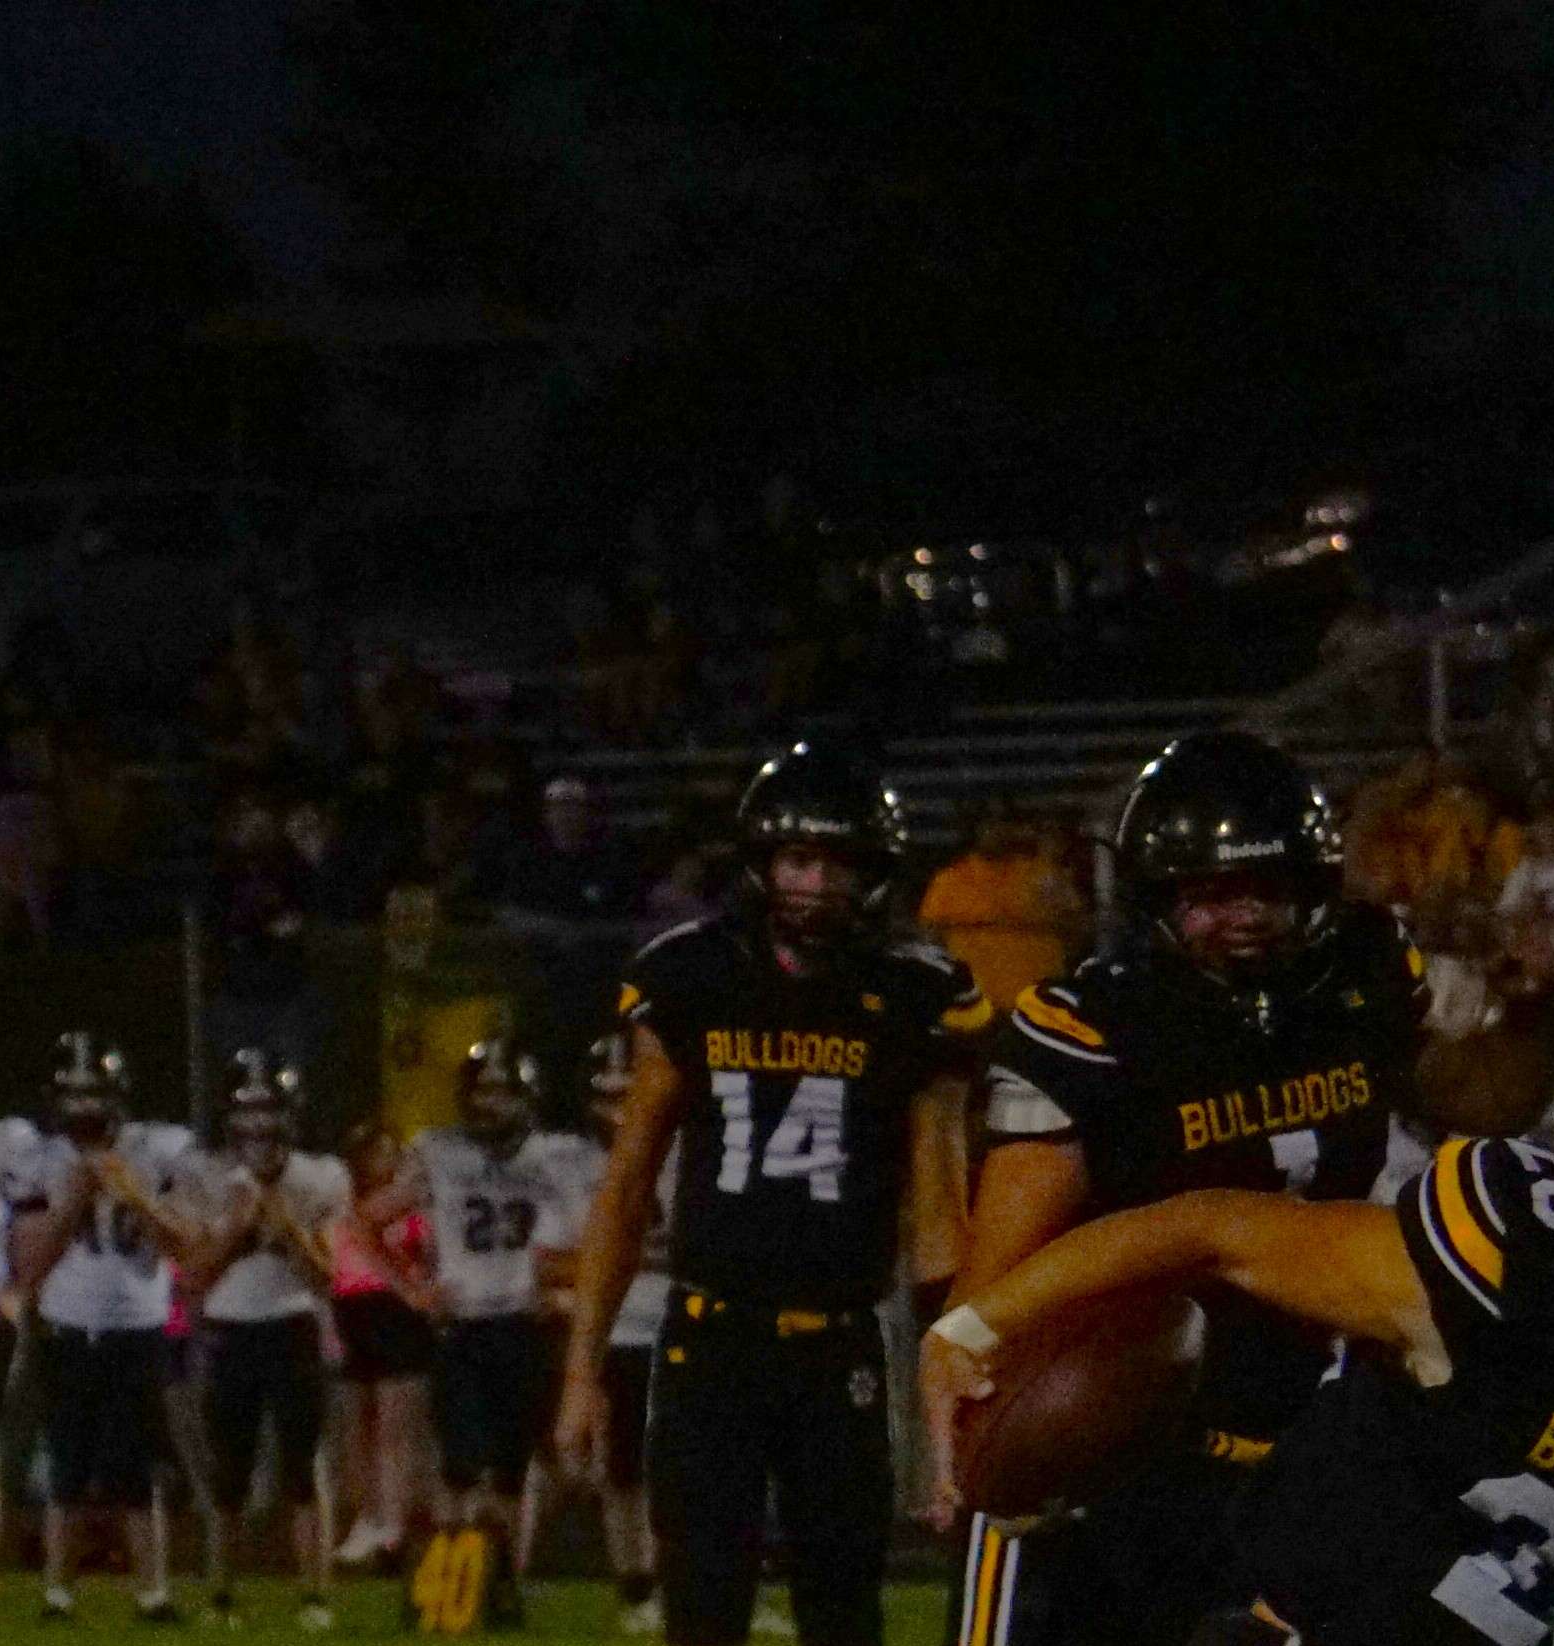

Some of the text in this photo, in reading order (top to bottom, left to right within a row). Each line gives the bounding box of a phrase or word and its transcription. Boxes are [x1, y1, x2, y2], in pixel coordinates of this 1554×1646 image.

[706, 1028, 870, 1079] BULLDOGS
[710, 1071, 849, 1202] 14
[1178, 1060, 1373, 1152] BULLDOGS
